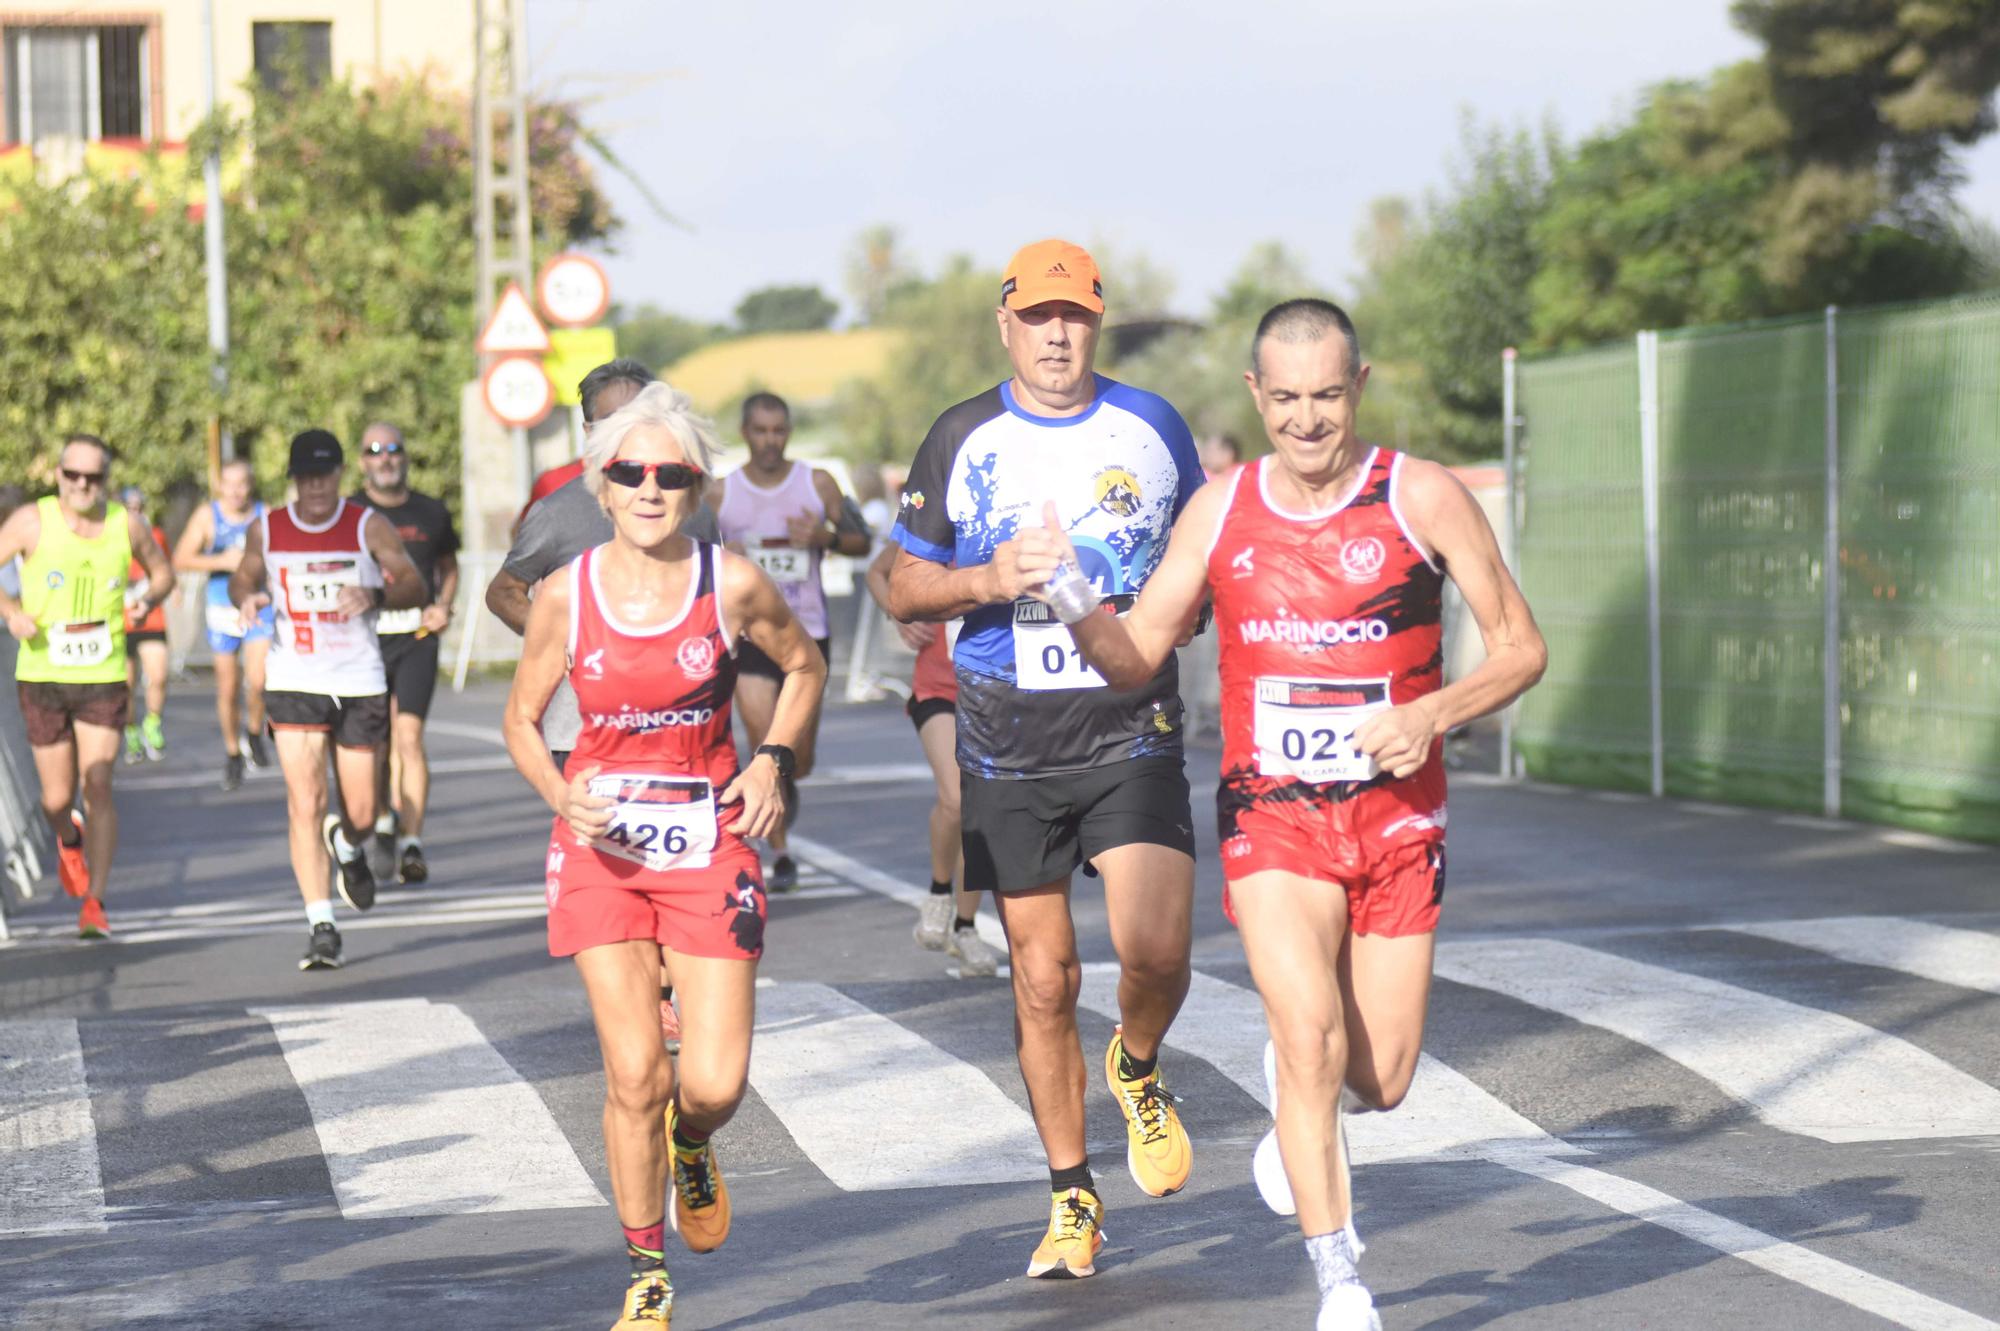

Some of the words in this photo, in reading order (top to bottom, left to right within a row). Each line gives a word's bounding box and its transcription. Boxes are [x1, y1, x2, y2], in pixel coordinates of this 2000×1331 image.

[1017, 602, 1049, 621] XXVIII
[62, 642, 99, 655] 419
[1042, 645, 1089, 674] 01
[604, 822, 688, 855] 426
